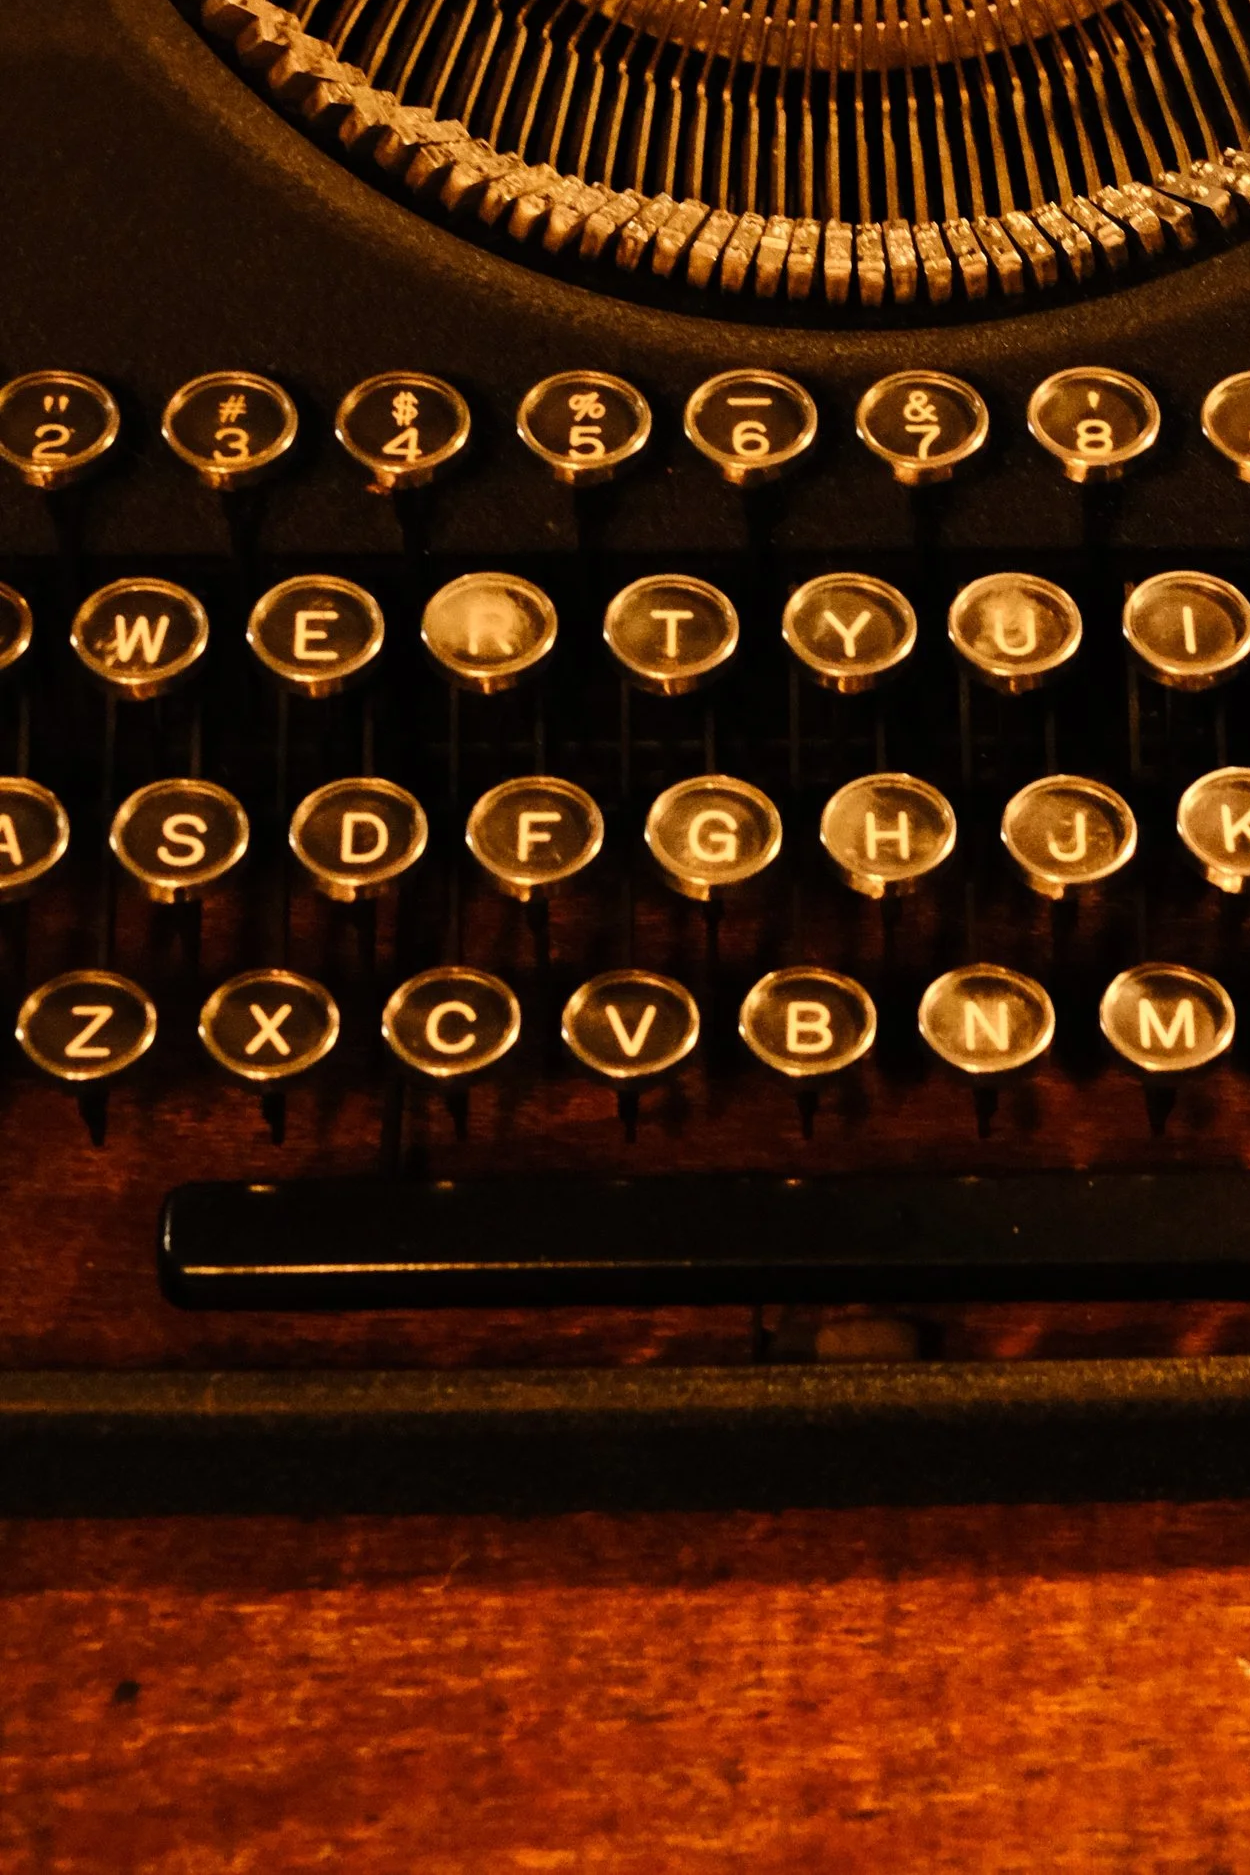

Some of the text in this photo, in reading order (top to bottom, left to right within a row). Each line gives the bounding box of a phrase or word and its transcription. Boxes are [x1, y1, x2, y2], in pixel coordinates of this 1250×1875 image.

[218, 394, 247, 424] #
[391, 391, 419, 426] $
[568, 391, 606, 422] %
[903, 390, 939, 424] &
[32, 424, 70, 460] 2
[212, 428, 250, 463] 3
[382, 427, 423, 462] 4
[568, 425, 605, 460] 5
[732, 421, 770, 457] 6
[904, 424, 941, 460] 7
[1076, 418, 1113, 456] 8
[114, 614, 170, 663] W
[293, 610, 339, 660] E
[469, 605, 514, 656] R
[650, 609, 694, 658] T
[823, 610, 871, 658] Y
[993, 607, 1036, 657] U
[1182, 605, 1198, 654] I
[157, 813, 208, 867] S
[340, 811, 389, 864] D
[517, 810, 562, 863] F
[688, 809, 738, 863] G
[864, 810, 911, 864] H
[1047, 810, 1087, 863] J
[64, 1005, 113, 1057] Z
[245, 1003, 293, 1055] X
[425, 1001, 478, 1054] C
[605, 1004, 657, 1057] V
[786, 1001, 834, 1053] B
[964, 1000, 1010, 1051] N
[1137, 998, 1196, 1049] M
